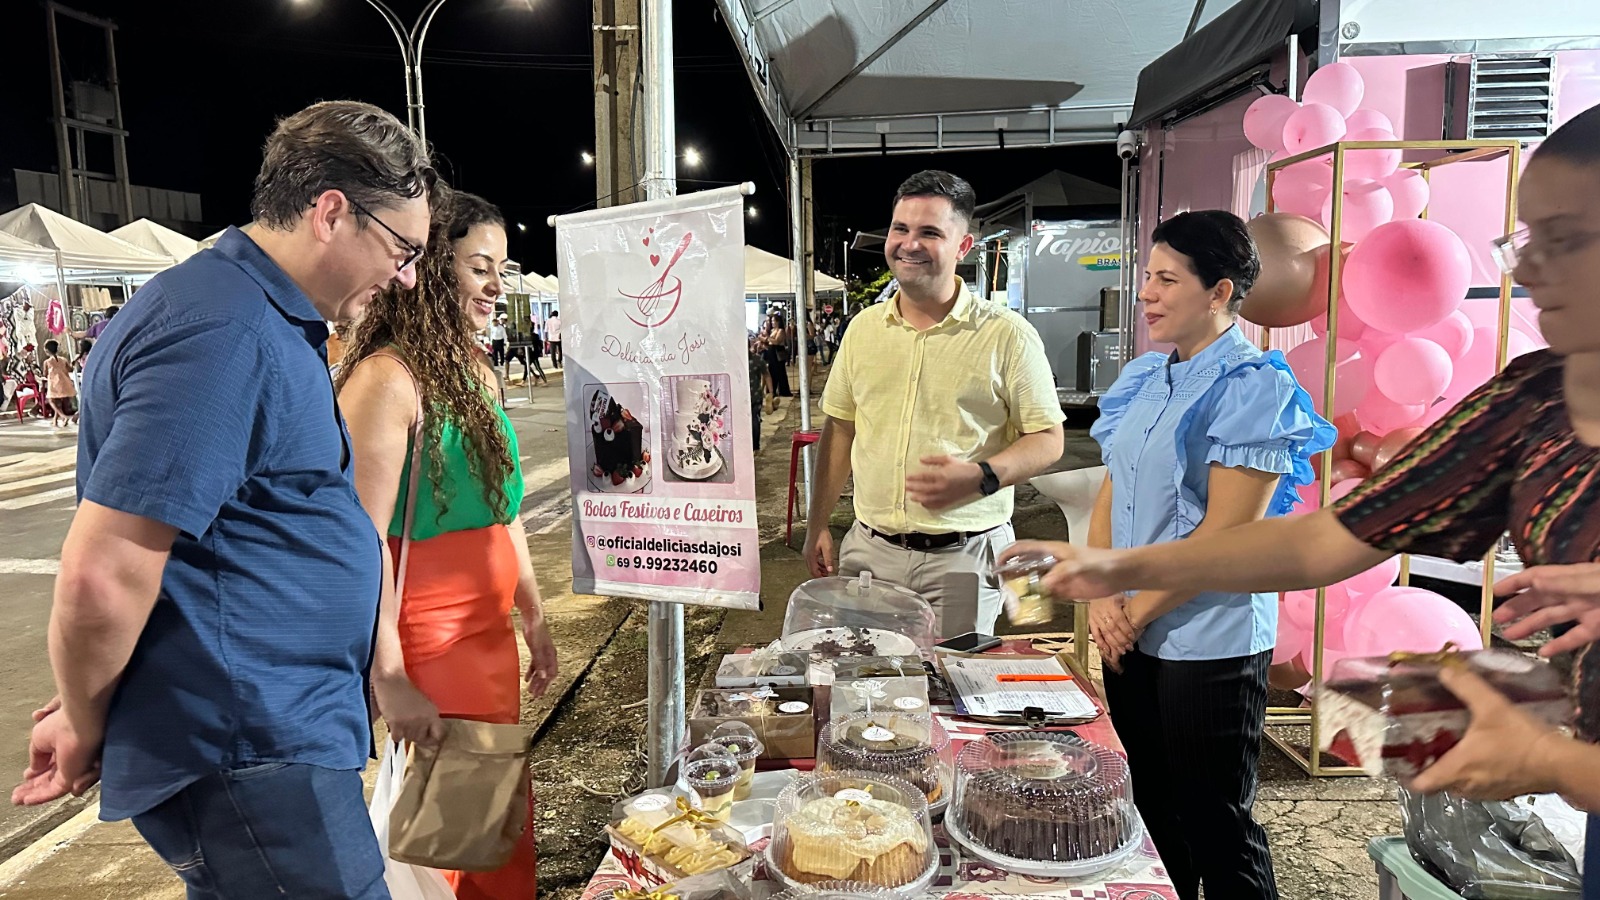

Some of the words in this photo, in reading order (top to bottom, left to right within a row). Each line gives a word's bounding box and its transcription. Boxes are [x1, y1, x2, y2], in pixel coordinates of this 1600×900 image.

[1035, 229, 1121, 262] Tapio
[1096, 257, 1122, 267] BRAS
[601, 334, 654, 364] Delicia
[660, 343, 676, 362] da
[678, 332, 706, 365] Josi
[583, 499, 617, 518] Bolos
[620, 500, 671, 520] Festivos
[673, 507, 681, 520] e
[683, 502, 743, 524] Caseiros
[596, 535, 742, 558] @oficialdeliciasdajosi
[616, 557, 631, 568] 69
[633, 556, 718, 575] 9.99232460
